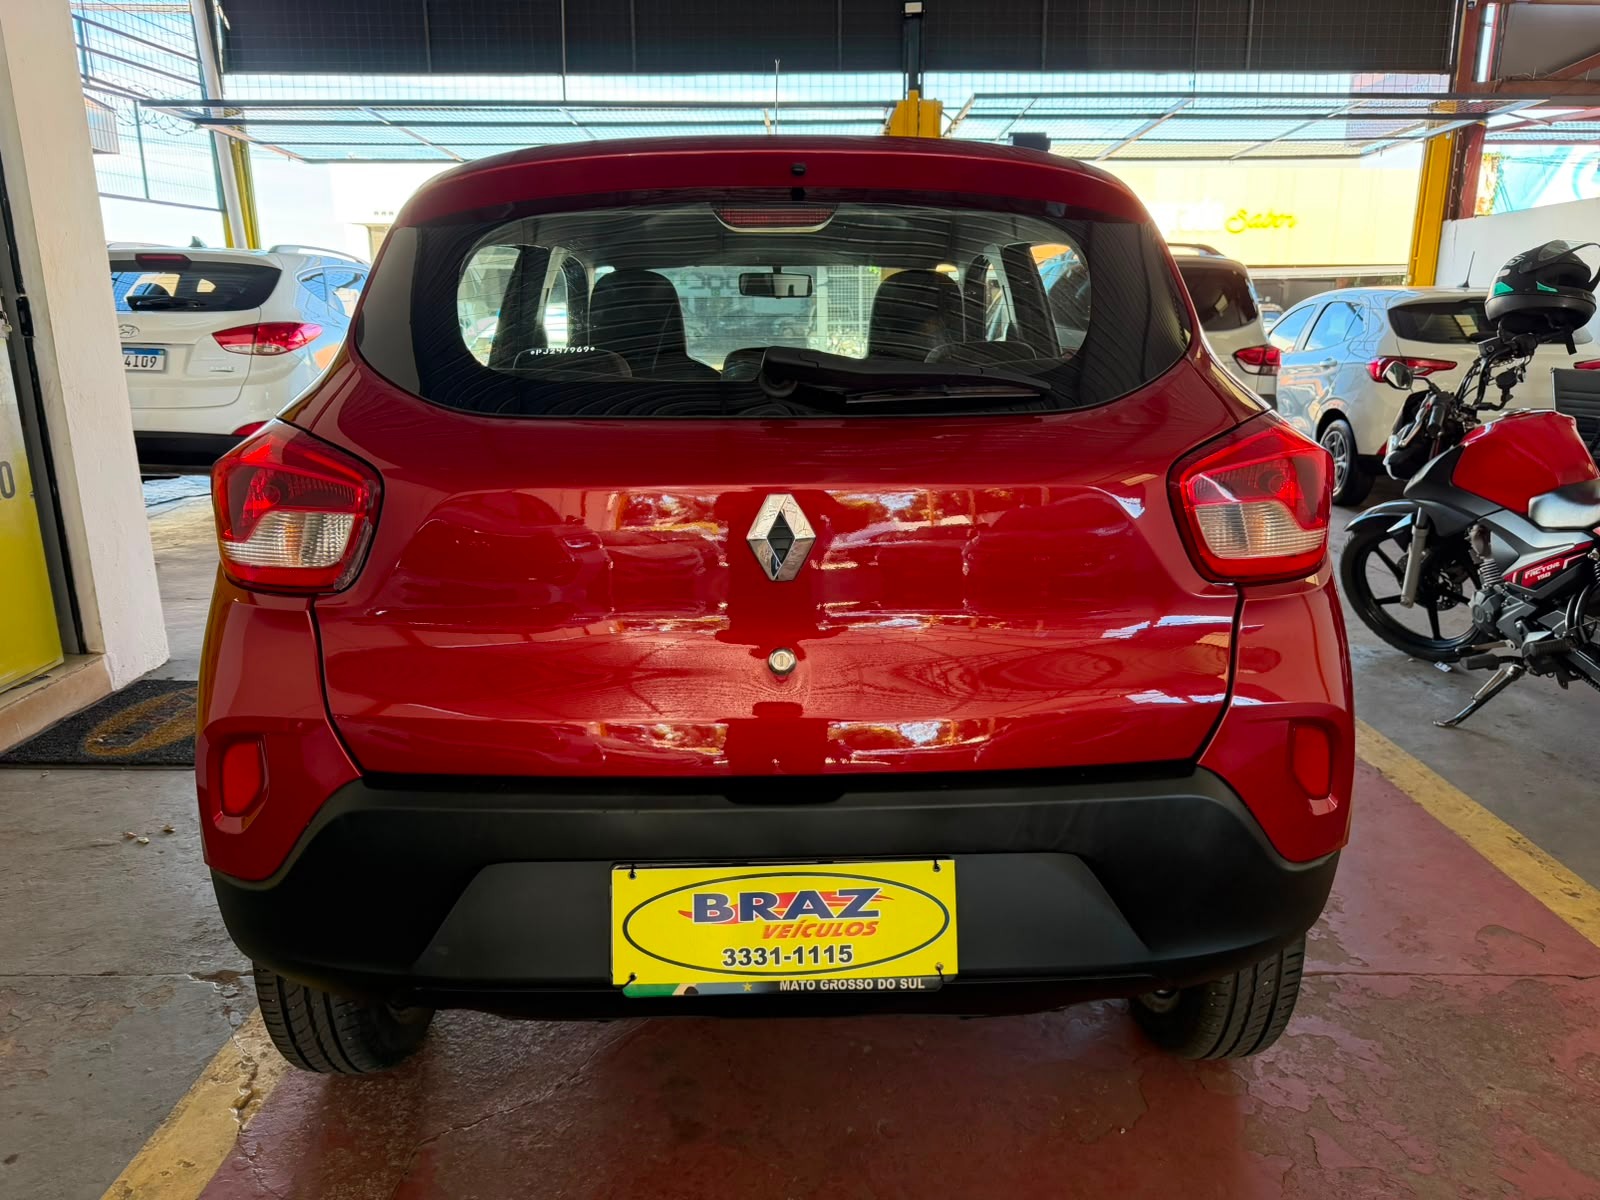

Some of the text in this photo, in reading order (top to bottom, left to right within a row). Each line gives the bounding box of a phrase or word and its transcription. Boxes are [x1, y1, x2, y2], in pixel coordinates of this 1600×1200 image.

[1525, 562, 1560, 579] FACTOR
[692, 887, 882, 925] BRAZ
[761, 920, 880, 940] VEÍCULOS
[722, 944, 853, 967] 3331-1115
[779, 977, 925, 991] MATO GROSSO DO SUL
